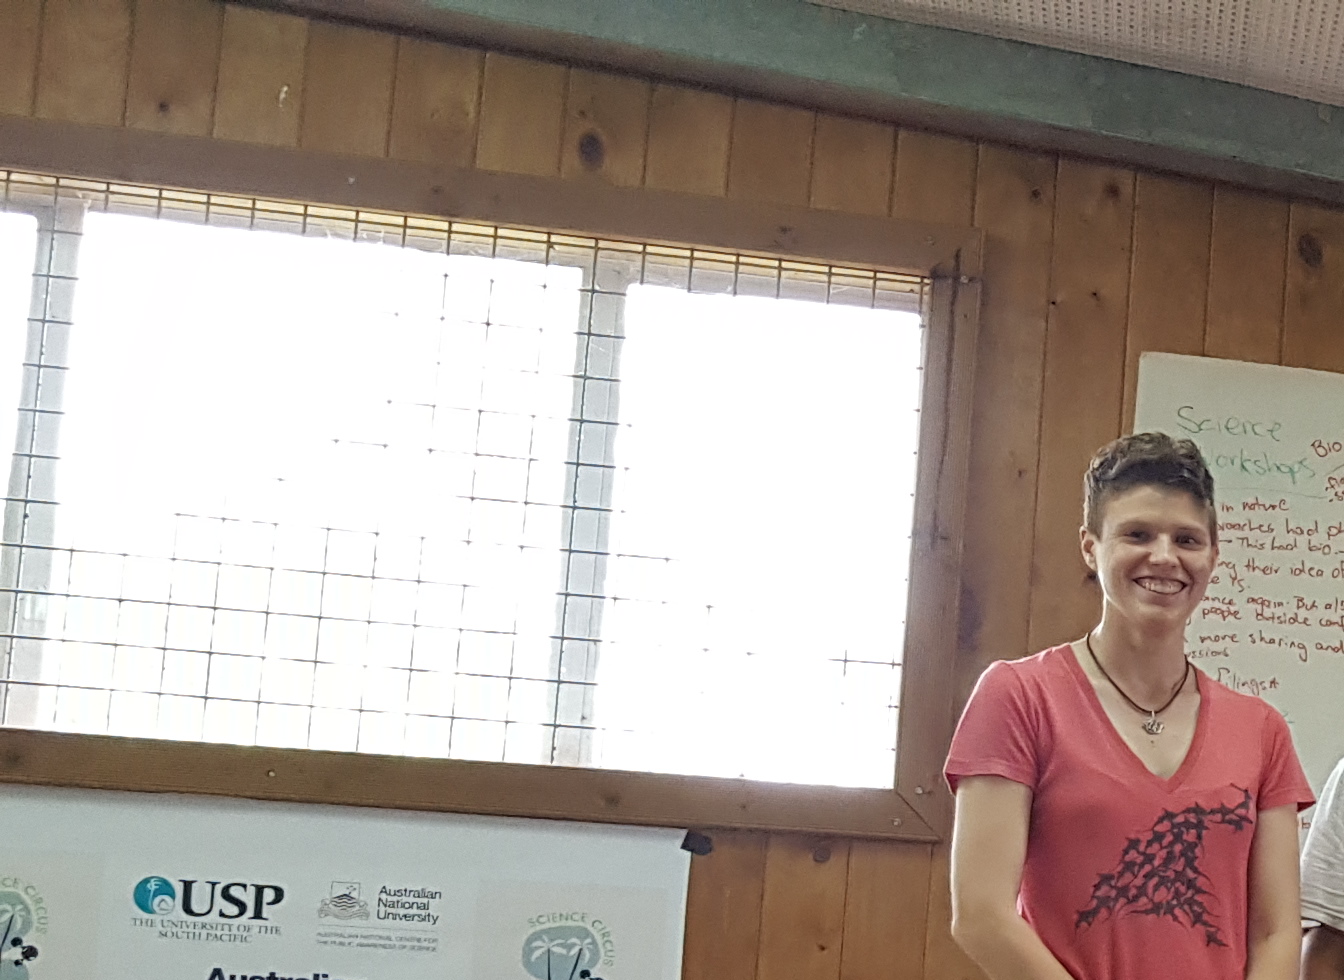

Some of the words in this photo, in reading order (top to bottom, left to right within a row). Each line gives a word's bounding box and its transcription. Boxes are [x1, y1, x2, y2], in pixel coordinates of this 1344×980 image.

[1177, 405, 1282, 441] Science
[1311, 439, 1342, 458] Bio
[1245, 557, 1281, 575] their
[1290, 559, 1324, 578] idea
[178, 879, 285, 921] USP
[379, 885, 442, 900] Australian
[377, 897, 430, 911] National
[131, 917, 156, 928] THE
[160, 919, 234, 933] UNIVERSITY
[236, 923, 253, 933] OF
[256, 925, 282, 936] THE
[376, 909, 440, 925] University
[158, 930, 202, 941] SOUTH
[205, 931, 253, 943] PACIFIC
[527, 911, 588, 927] SCIENCE
[591, 919, 615, 968] CIRCUS
